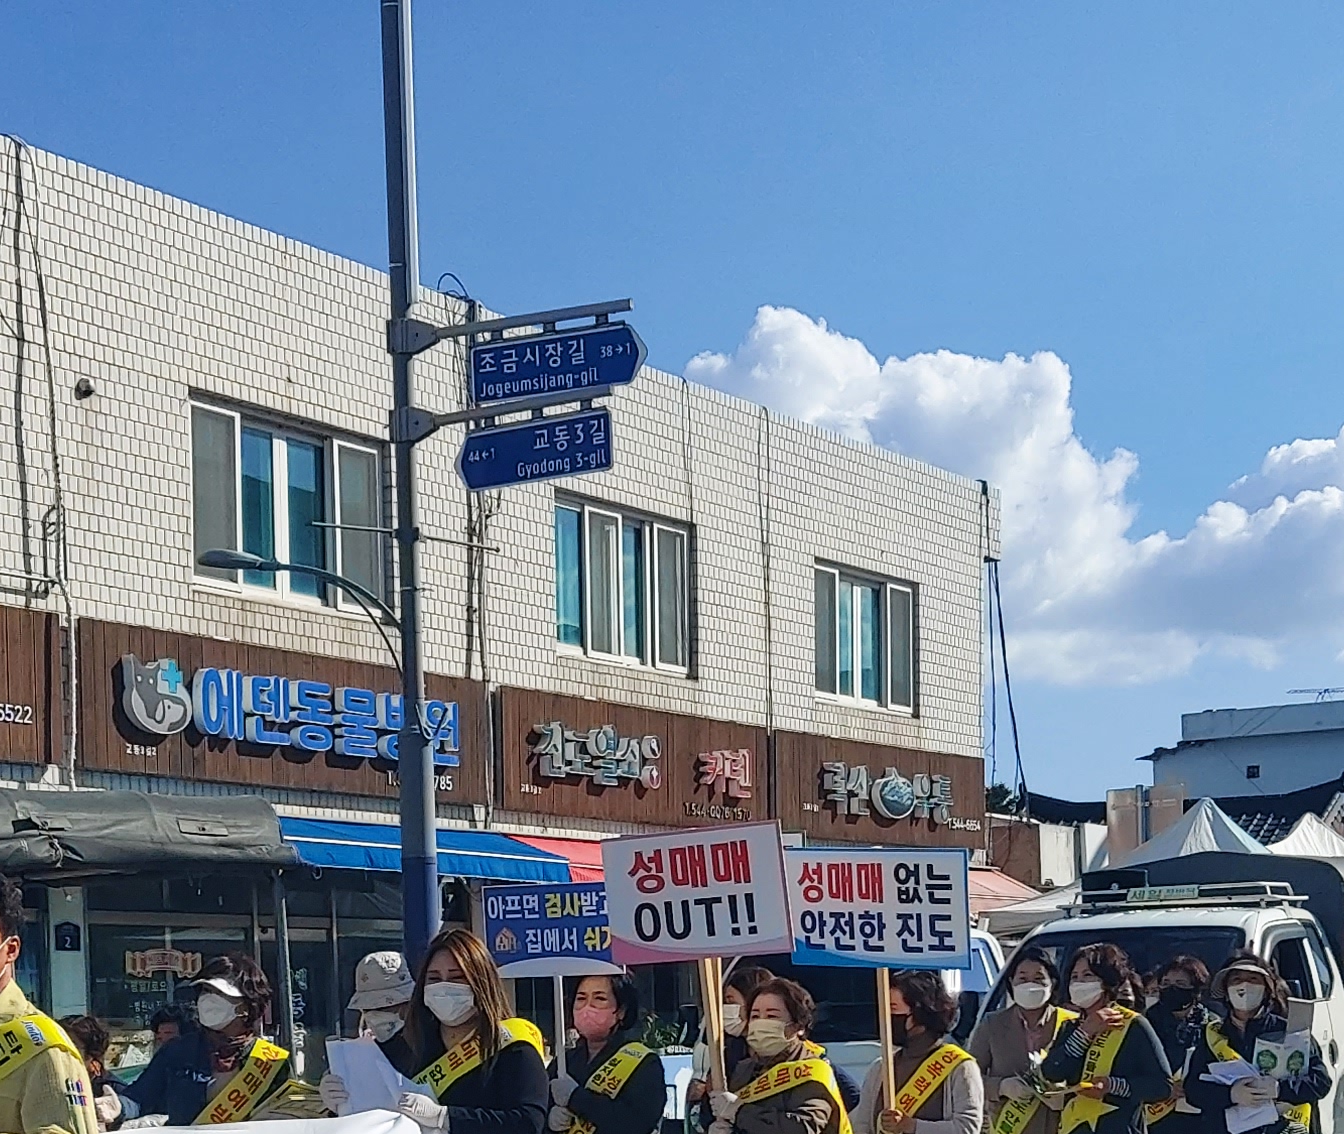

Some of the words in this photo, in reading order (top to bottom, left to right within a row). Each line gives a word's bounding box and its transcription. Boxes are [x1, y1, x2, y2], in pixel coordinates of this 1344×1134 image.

[478, 338, 587, 374] 조금시장길
[599, 344, 614, 359] 38
[479, 366, 600, 399] Jogeumsijang-gil
[467, 449, 482, 463] 44
[532, 418, 607, 452] 교동3길
[516, 456, 571, 479] Gyodong
[575, 449, 607, 470] 3-gil
[628, 839, 752, 895] 성매매
[797, 860, 885, 904] 성매매
[893, 862, 954, 906] 없는
[487, 894, 540, 921] 아프면
[633, 892, 758, 943] OUT!!
[524, 926, 578, 954] 집에서
[800, 911, 886, 953] 안전한
[896, 911, 955, 952] 진도
[446, 1033, 484, 1072] 매매
